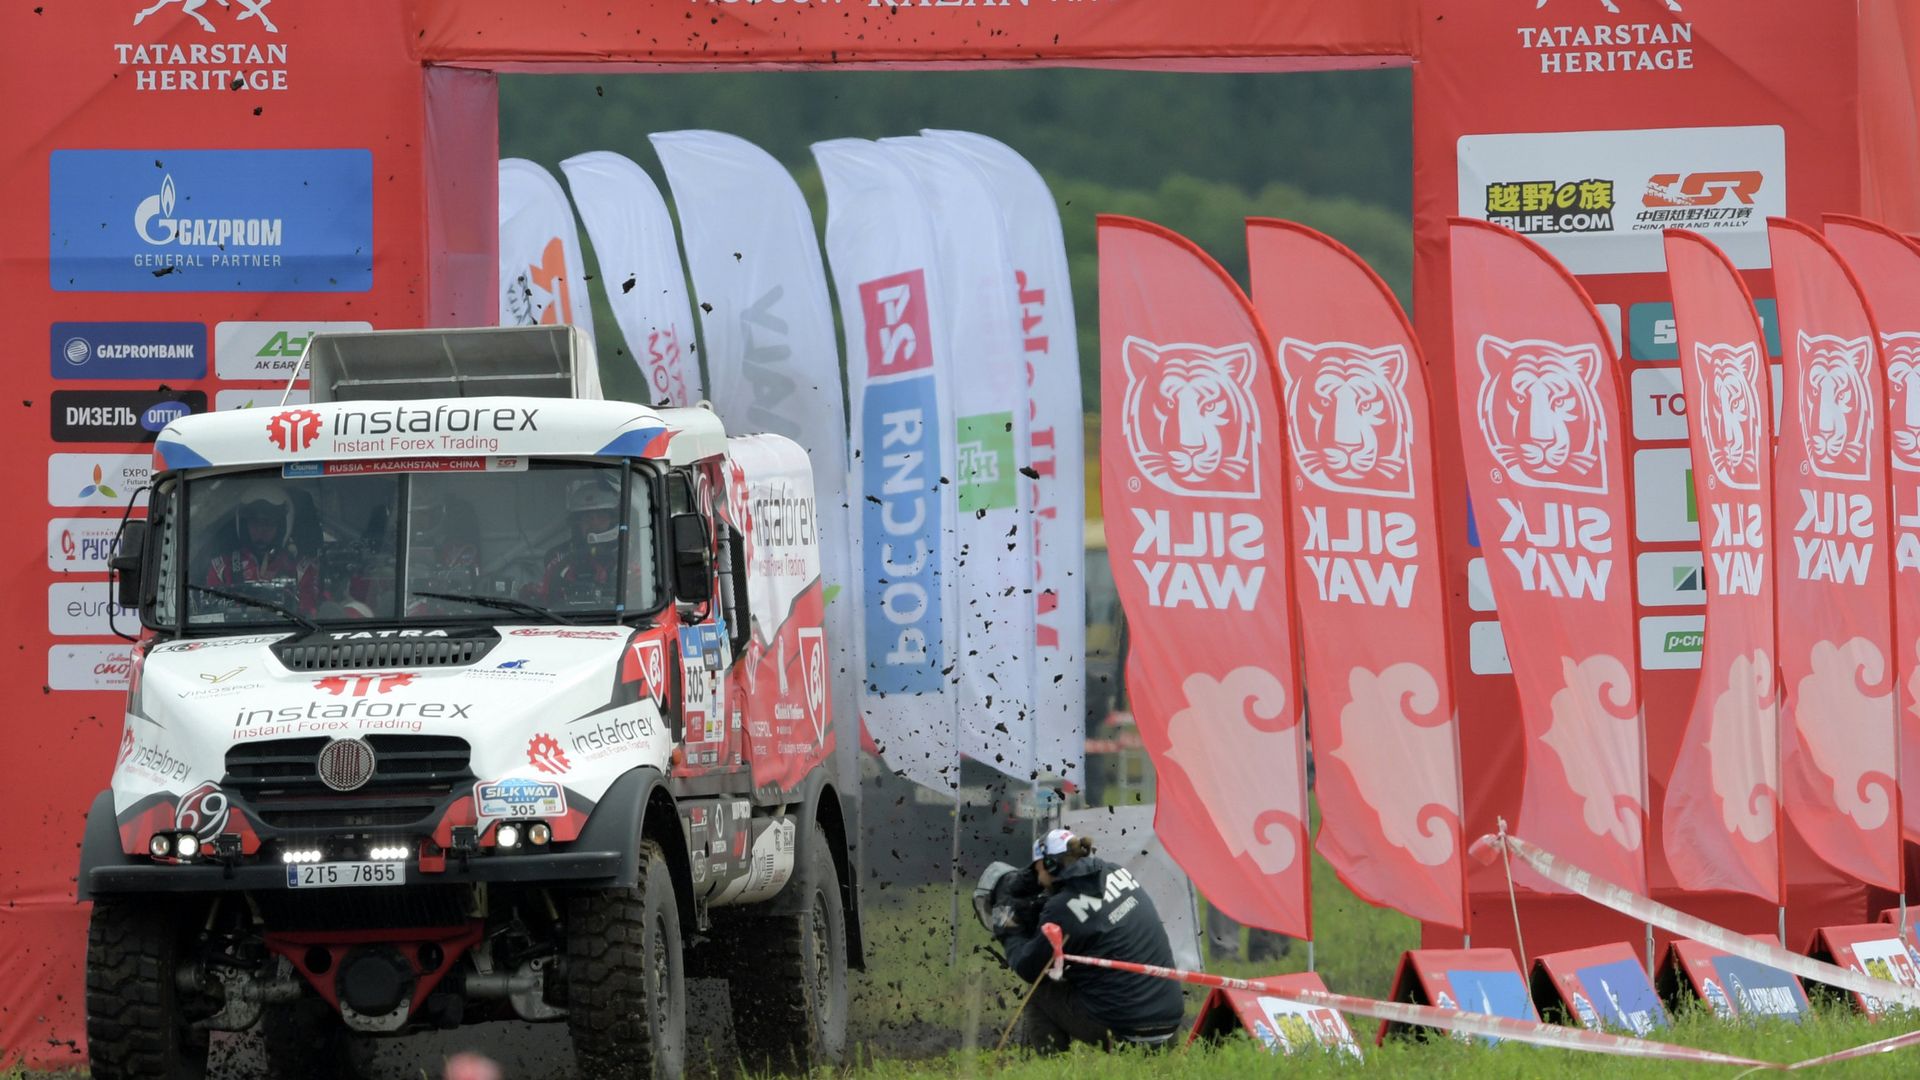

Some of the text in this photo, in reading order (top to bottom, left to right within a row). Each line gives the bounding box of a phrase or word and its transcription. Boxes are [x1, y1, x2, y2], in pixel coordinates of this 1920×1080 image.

[1517, 23, 1692, 48] TATARSTAN
[114, 43, 288, 65] TATARSTAN
[1540, 49, 1694, 74] HERITAGE
[135, 69, 288, 91] HERITAGE
[179, 218, 283, 247] GAZPROM
[1632, 223, 1666, 231] CHINA
[1714, 220, 1749, 228] RALLY
[134, 254, 282, 268] GENERAL PARTNER
[97, 343, 194, 359] GAZPROMBANK
[333, 404, 540, 436] instaforex
[333, 435, 499, 453] Instant Forex Trading
[122, 468, 148, 478] EXPO
[329, 463, 364, 473] RUSSIA
[373, 461, 439, 471] KAZAKHSTAN
[449, 460, 480, 470] CHINA
[330, 629, 449, 641] TATRA
[686, 665, 704, 704] 305
[236, 698, 473, 727] instaforex
[233, 718, 423, 740] Instant Forex Trading
[569, 717, 656, 754] instaforex
[132, 738, 192, 783] instaforex
[485, 786, 553, 798] SILK WAY
[511, 805, 536, 816] 305
[305, 864, 396, 884] 2T5 7855
